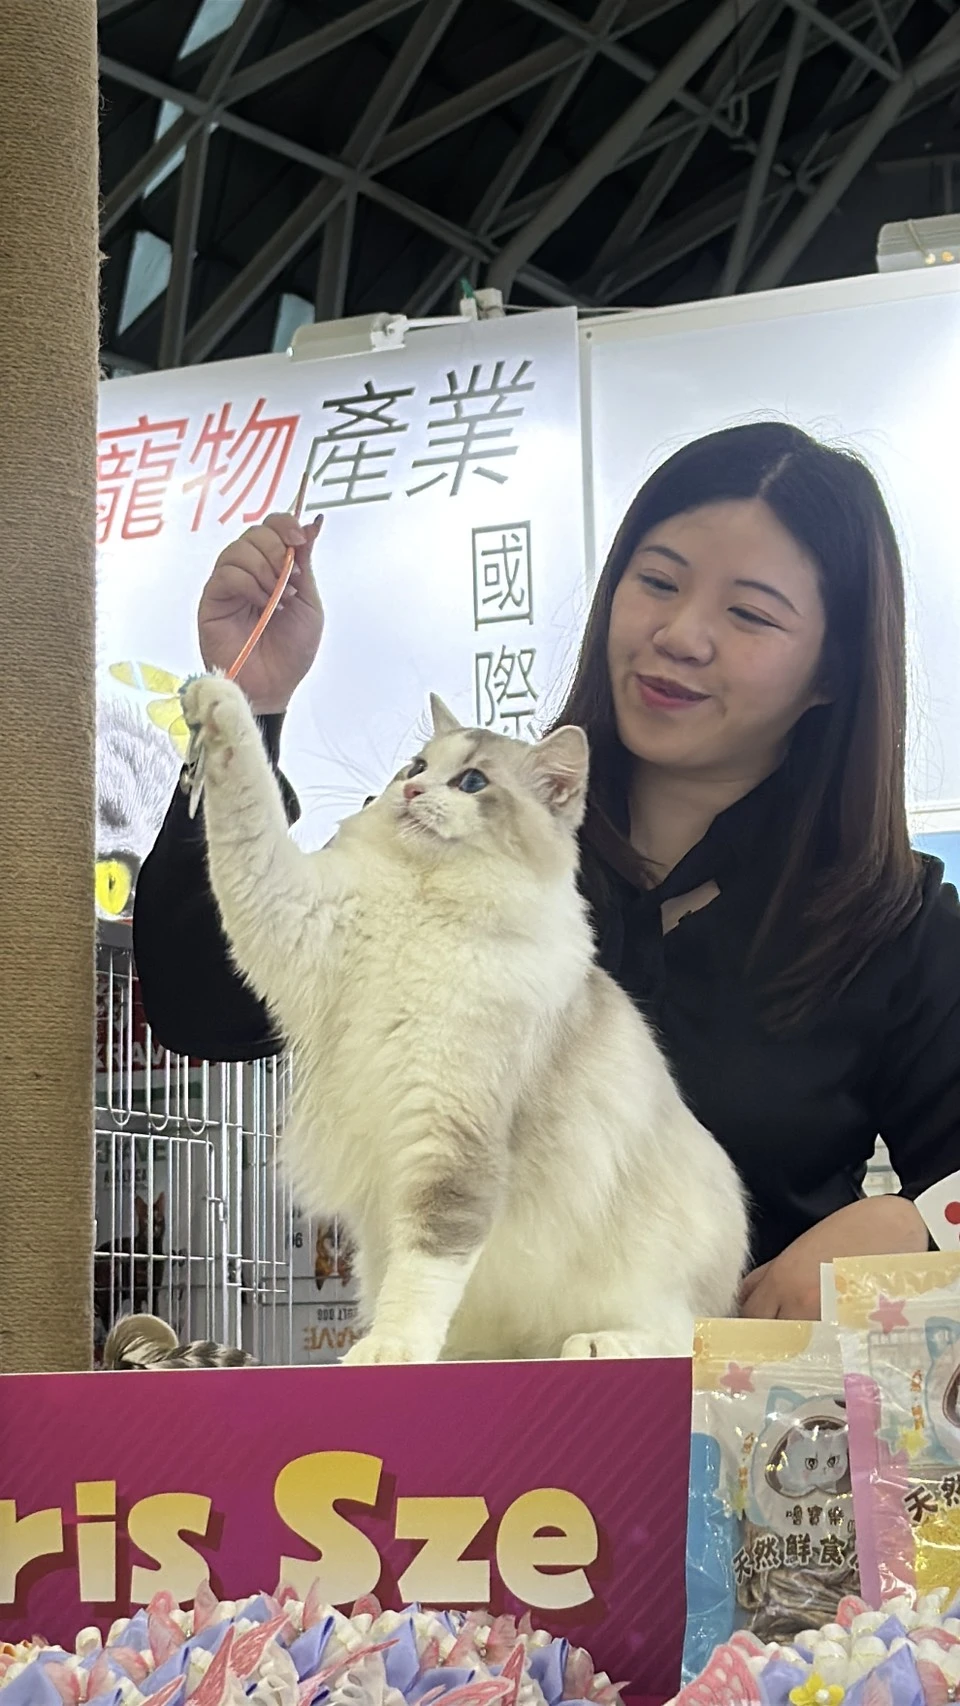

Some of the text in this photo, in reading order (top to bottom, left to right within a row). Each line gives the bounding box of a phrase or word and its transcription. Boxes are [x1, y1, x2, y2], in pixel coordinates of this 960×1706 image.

[97, 359, 536, 543] 寵物產業
[471, 519, 540, 742] 國際
[0, 1480, 212, 1604] ris
[273, 1450, 599, 1610] Sze
